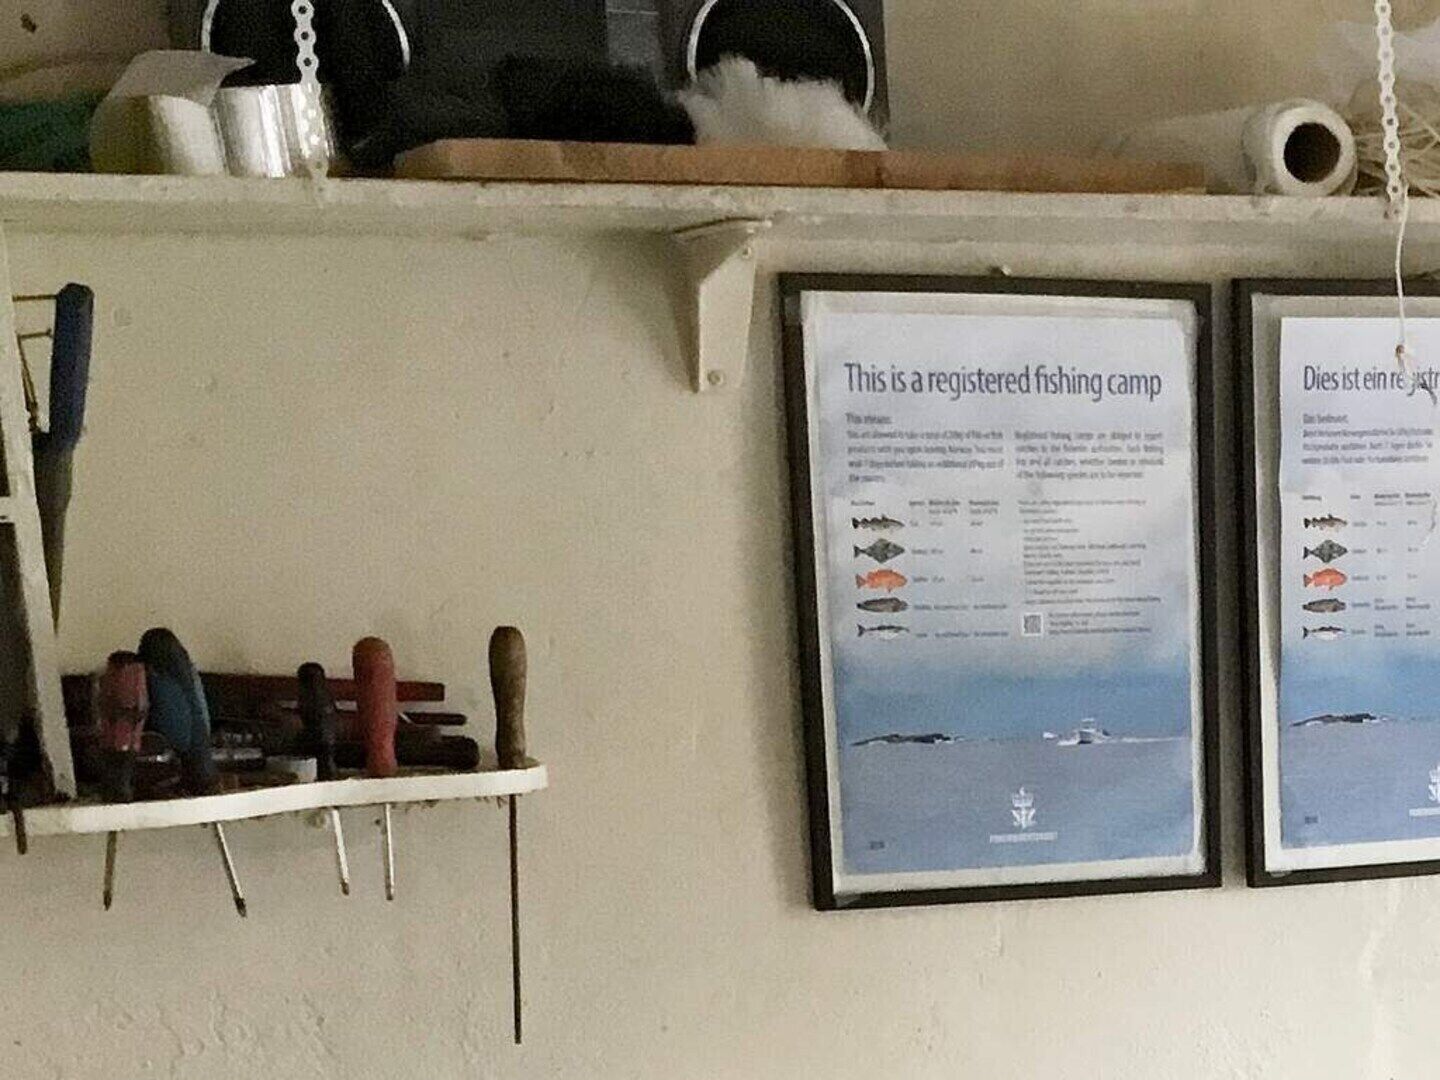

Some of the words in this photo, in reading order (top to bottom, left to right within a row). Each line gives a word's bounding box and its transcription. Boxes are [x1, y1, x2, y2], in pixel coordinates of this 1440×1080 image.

[844, 362, 887, 394] This
[891, 364, 907, 394] is
[911, 370, 923, 394] a
[928, 364, 1030, 401] registered
[1034, 365, 1103, 402] fishing
[1107, 370, 1162, 402] camp
[1303, 364, 1339, 391] Dies
[1342, 365, 1361, 391] ist
[1363, 366, 1388, 391] ein
